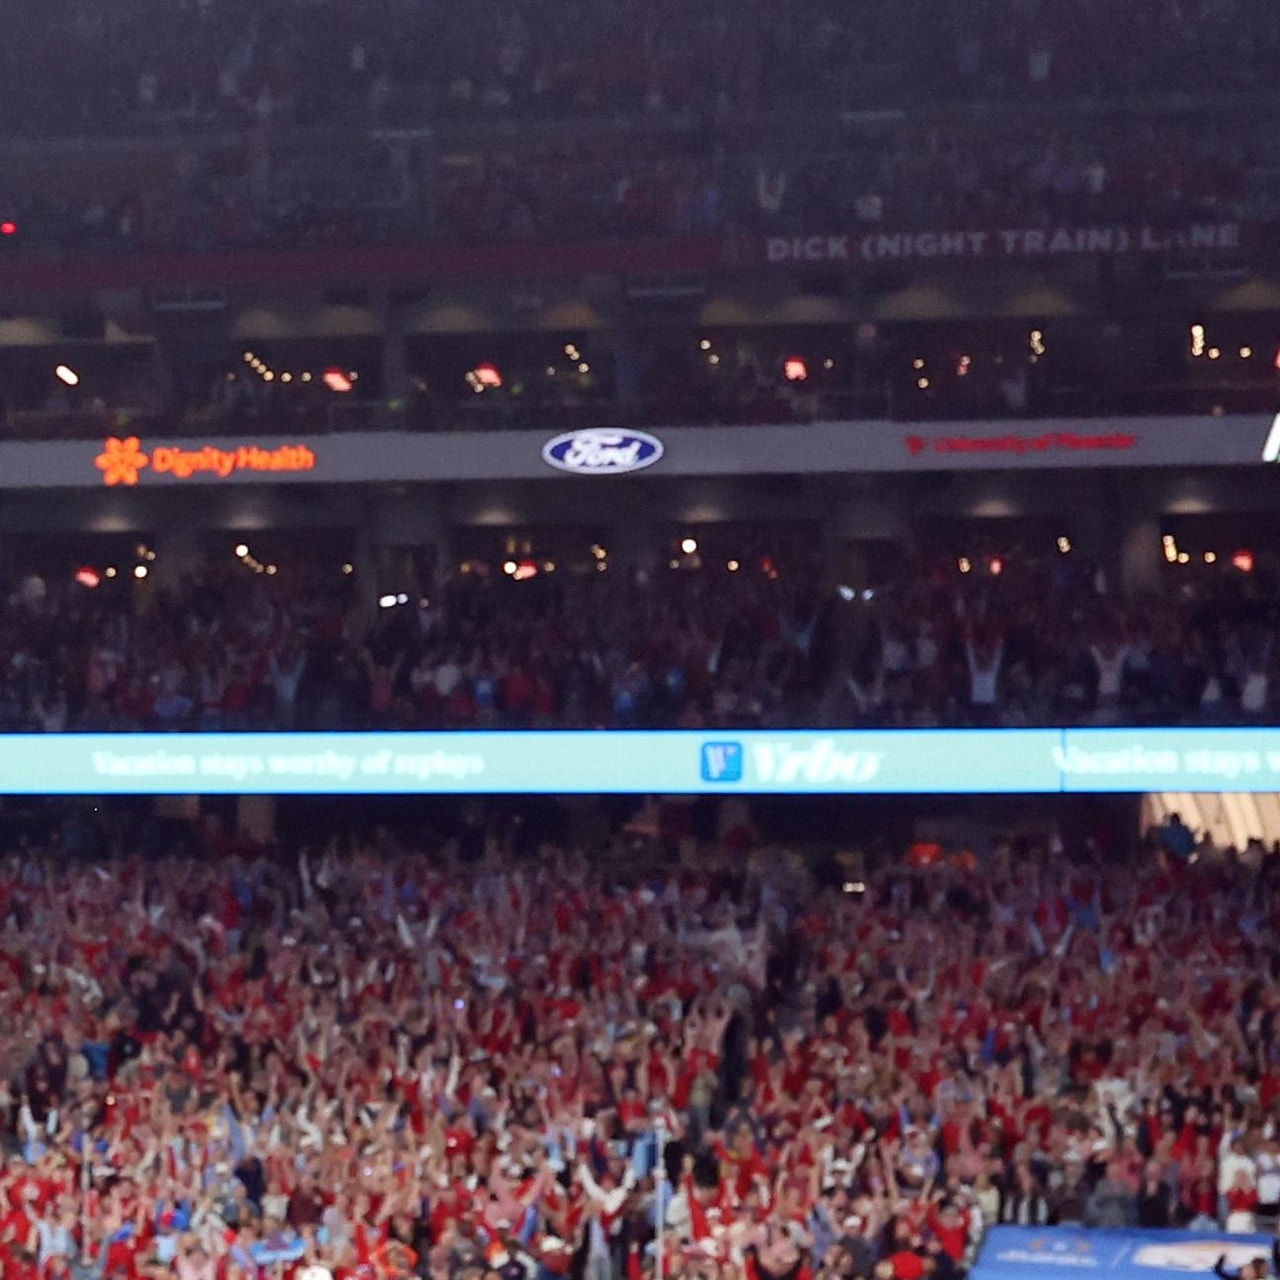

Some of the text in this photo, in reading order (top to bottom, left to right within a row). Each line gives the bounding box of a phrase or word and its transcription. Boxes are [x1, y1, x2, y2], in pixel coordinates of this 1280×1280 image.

[767, 234, 848, 262] DICK
[152, 444, 316, 478] Dignity Health
[753, 739, 885, 783] Vrbo
